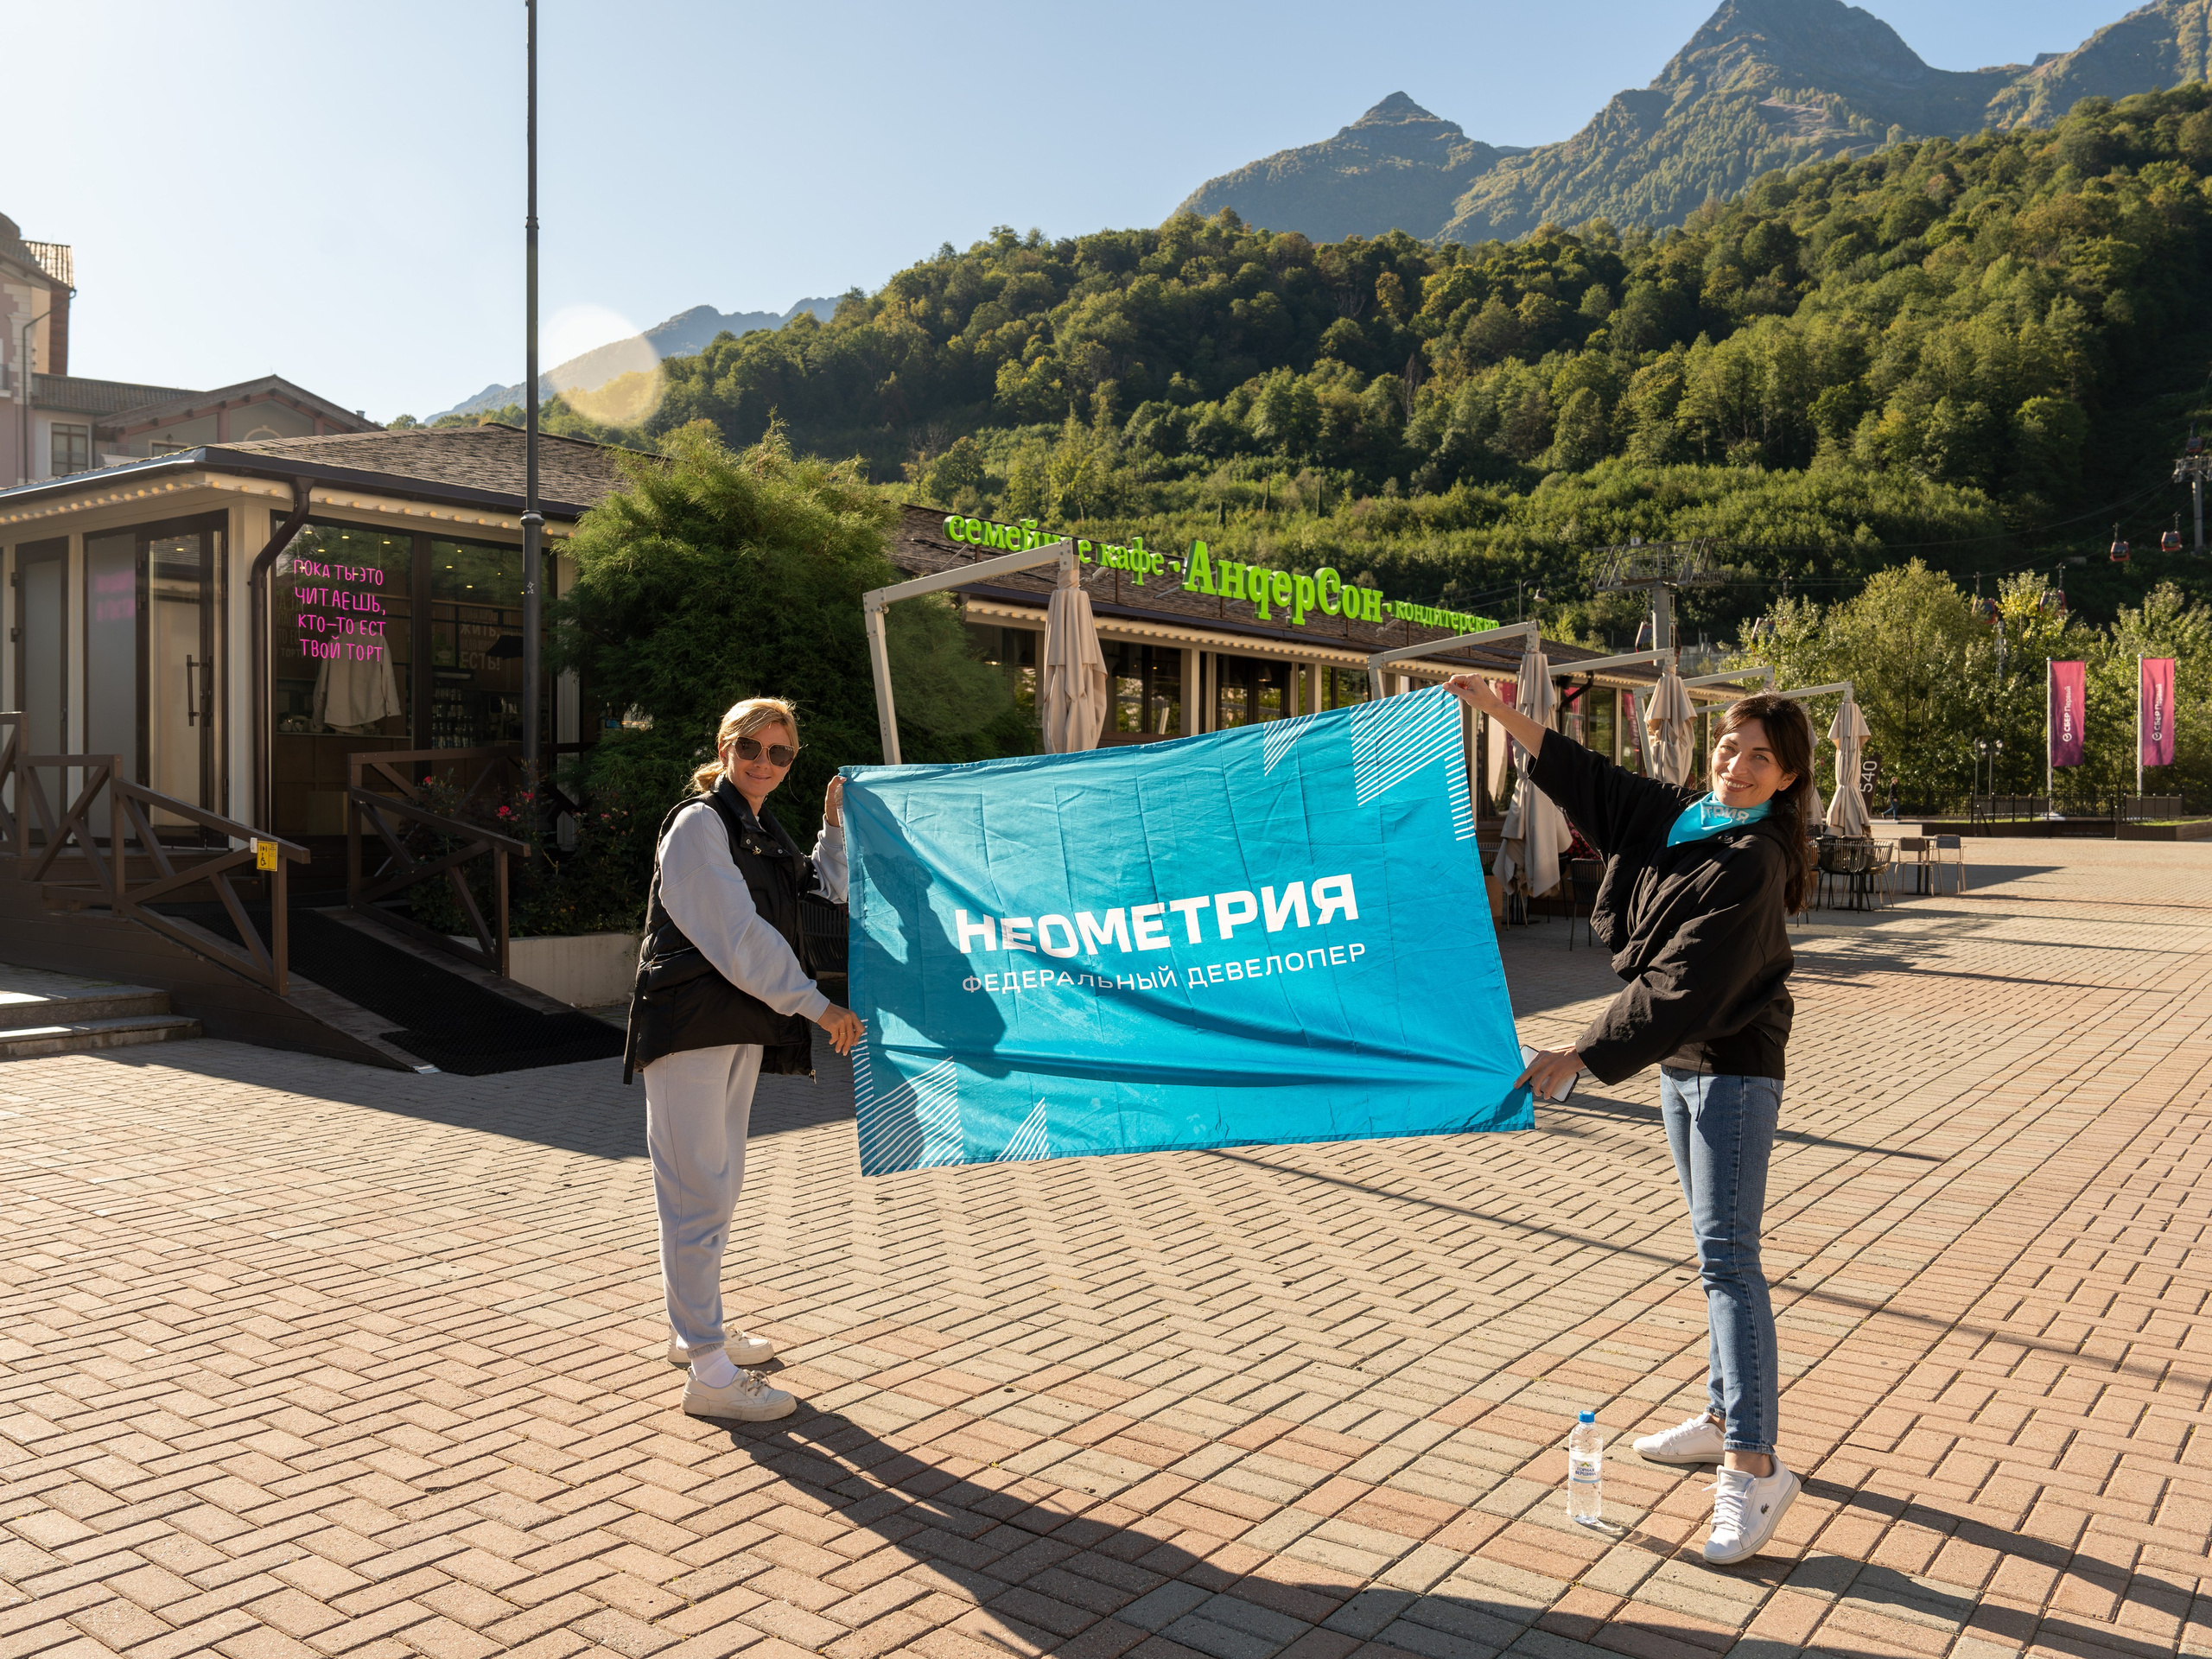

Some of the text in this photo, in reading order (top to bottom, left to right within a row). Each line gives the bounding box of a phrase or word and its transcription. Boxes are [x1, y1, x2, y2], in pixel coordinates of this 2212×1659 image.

[294, 559, 384, 586] ПОКА ТЫ ЭТО
[943, 515, 1091, 563] семейе
[1096, 537, 1164, 586] кафе
[1391, 600, 1500, 637] кондитерские
[295, 587, 386, 616] ЧИТАЕШЬ,
[298, 613, 354, 635] КТО-ТО
[359, 620, 386, 637] ЕСТ
[299, 635, 384, 662] ТВОЙ ТОРТ
[461, 652, 500, 671] ЕСТЬ!
[1859, 760, 1878, 793] 540
[955, 874, 1359, 958] НЕОМЕТРИЯ
[962, 943, 1367, 993] ФЕДЕРАЛЬНЫЙ ДЕВЕЛОПЕР
